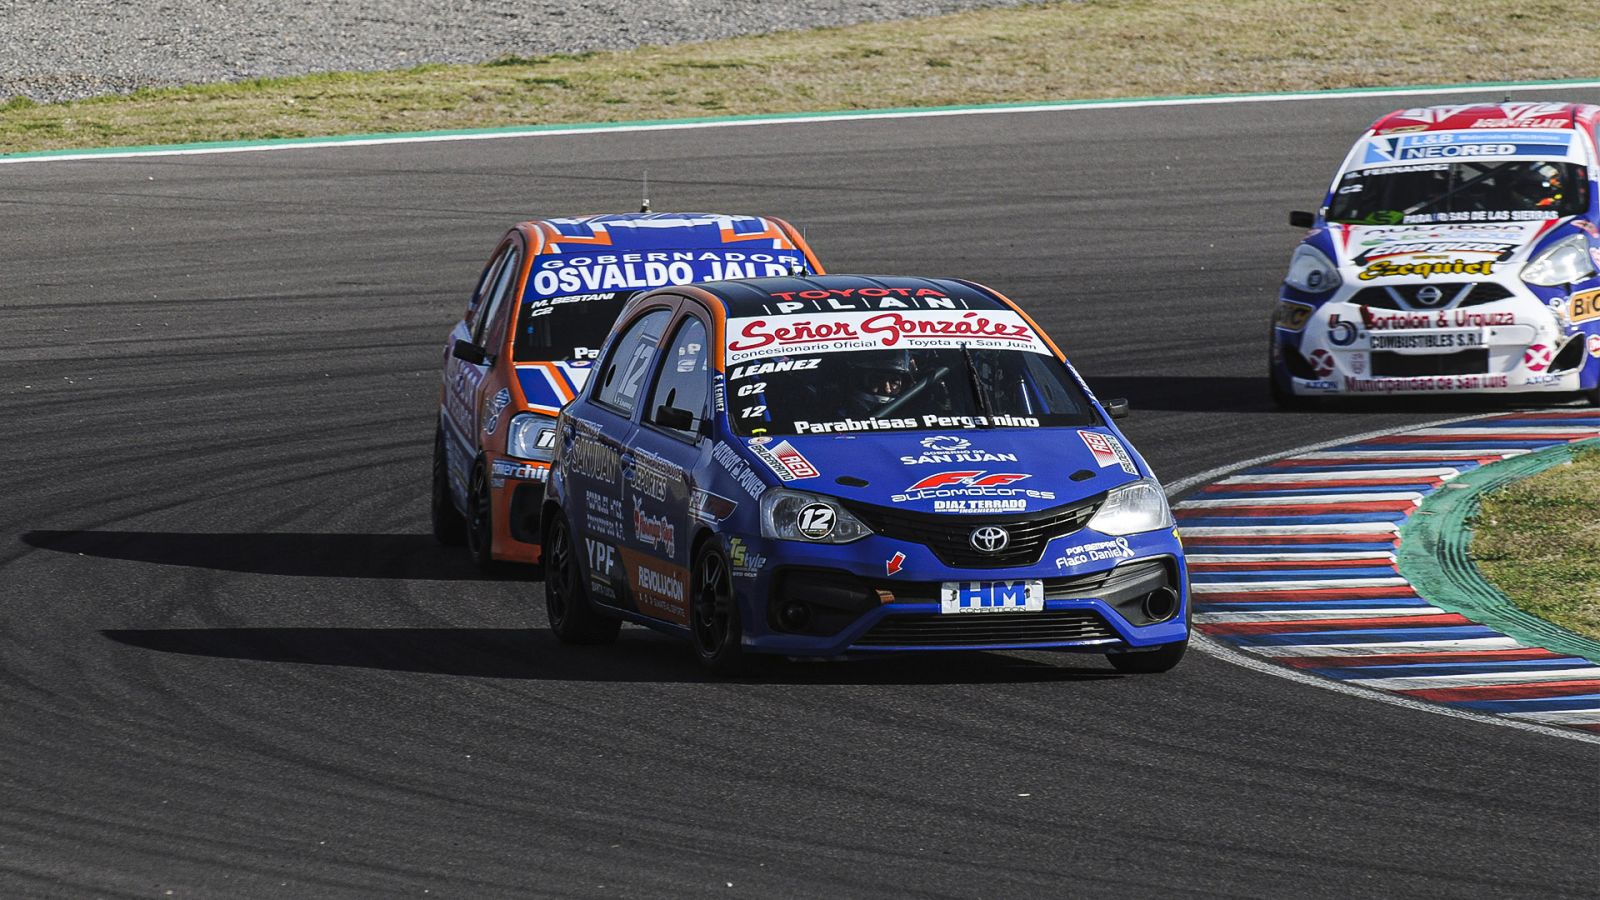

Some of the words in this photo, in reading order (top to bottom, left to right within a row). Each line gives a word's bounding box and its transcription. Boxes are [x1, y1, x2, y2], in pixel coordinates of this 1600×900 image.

[1406, 145, 1518, 159] NEORED
[1471, 212, 1487, 221] DE
[1488, 211, 1510, 220] LAS
[1511, 210, 1559, 220] SIERRAS
[542, 252, 800, 268] GOBERNADOR
[1358, 259, 1494, 280] Ezequiel
[534, 261, 694, 296] OSVALDO
[550, 292, 615, 306] BESTANI
[770, 287, 946, 301] TOYOTA
[531, 306, 554, 317] C2
[1367, 312, 1431, 330] Bortolon
[1436, 310, 1449, 328] &
[1455, 310, 1515, 329] Urquiza
[729, 320, 858, 351] Señor
[860, 312, 1033, 346] González
[731, 343, 829, 361] Concesionario
[833, 340, 877, 349] Oficial
[907, 339, 951, 347] Toyota
[976, 339, 998, 347] San
[1006, 340, 1037, 350] Juan
[1371, 334, 1455, 349] COMBUSTIBLES
[619, 343, 656, 398] 12
[730, 358, 822, 380] LEANEZ
[737, 382, 767, 398] C2
[1345, 376, 1434, 394] Municipalidad
[1438, 376, 1454, 390] de
[1456, 376, 1479, 390] San
[1483, 375, 1508, 389] Luis
[714, 383, 725, 412] LEANEZ
[741, 405, 767, 419] 12
[794, 416, 918, 434] Parabrisas
[783, 454, 813, 478] RED
[900, 454, 953, 465] SAN
[956, 453, 1018, 463] JUAN
[713, 440, 741, 473] PATRIOT
[736, 468, 767, 501] POWER
[891, 487, 1056, 503] automotores
[934, 500, 967, 509] DIAZ
[968, 499, 1027, 509] TERRADO
[802, 508, 833, 530] 12
[585, 537, 616, 576] YPF
[1066, 546, 1084, 556] POR
[1083, 540, 1117, 552] SIEMPRE
[1056, 554, 1087, 569] Flaco
[1089, 547, 1122, 561] Daniel
[959, 581, 1026, 607] HM
